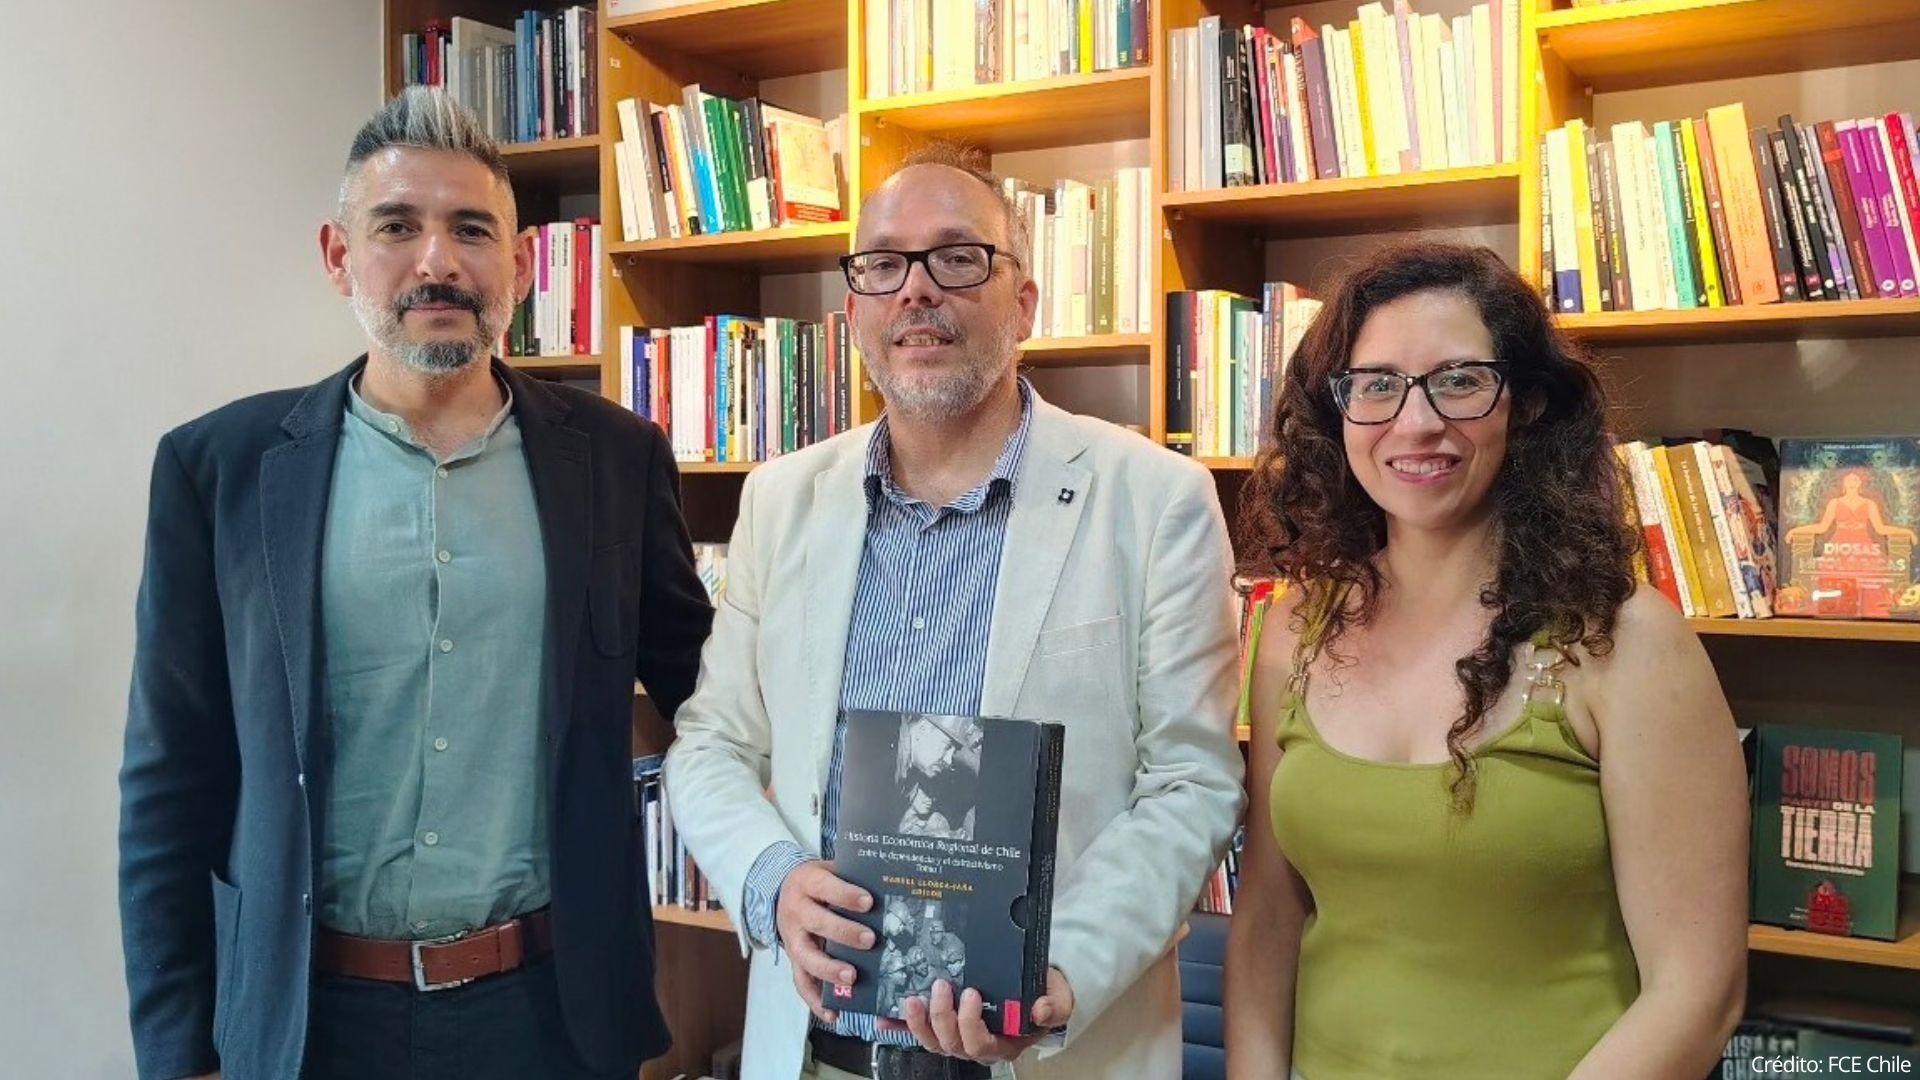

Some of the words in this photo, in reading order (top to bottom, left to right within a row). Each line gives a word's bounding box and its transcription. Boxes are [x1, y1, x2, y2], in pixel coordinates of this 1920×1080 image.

[1824, 543, 1880, 556] DIOSAS
[1782, 745, 1876, 804] SOMOS
[1832, 801, 1853, 813] DE
[1855, 803, 1876, 814] LA
[882, 834, 934, 849] Económica
[936, 840, 979, 856] Regional
[981, 846, 994, 855] de
[996, 846, 1021, 859] Chile
[1780, 805, 1873, 868] TIERRA
